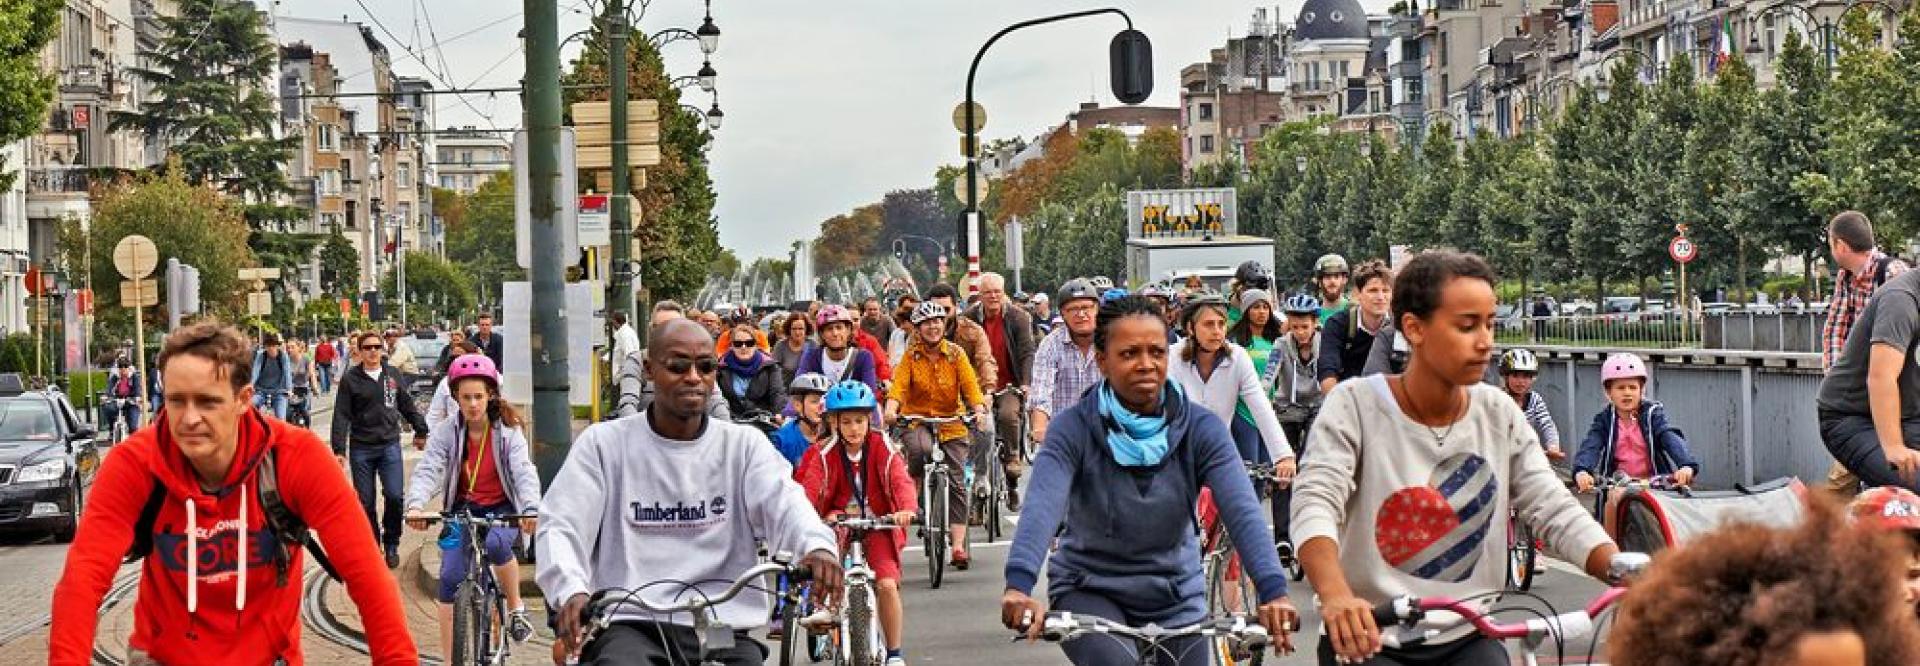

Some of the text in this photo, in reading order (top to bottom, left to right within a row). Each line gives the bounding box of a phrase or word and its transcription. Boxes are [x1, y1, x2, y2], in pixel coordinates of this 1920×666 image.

[1677, 243, 1690, 252] 70
[630, 500, 706, 521] Timberland
[173, 537, 262, 570] CORE
